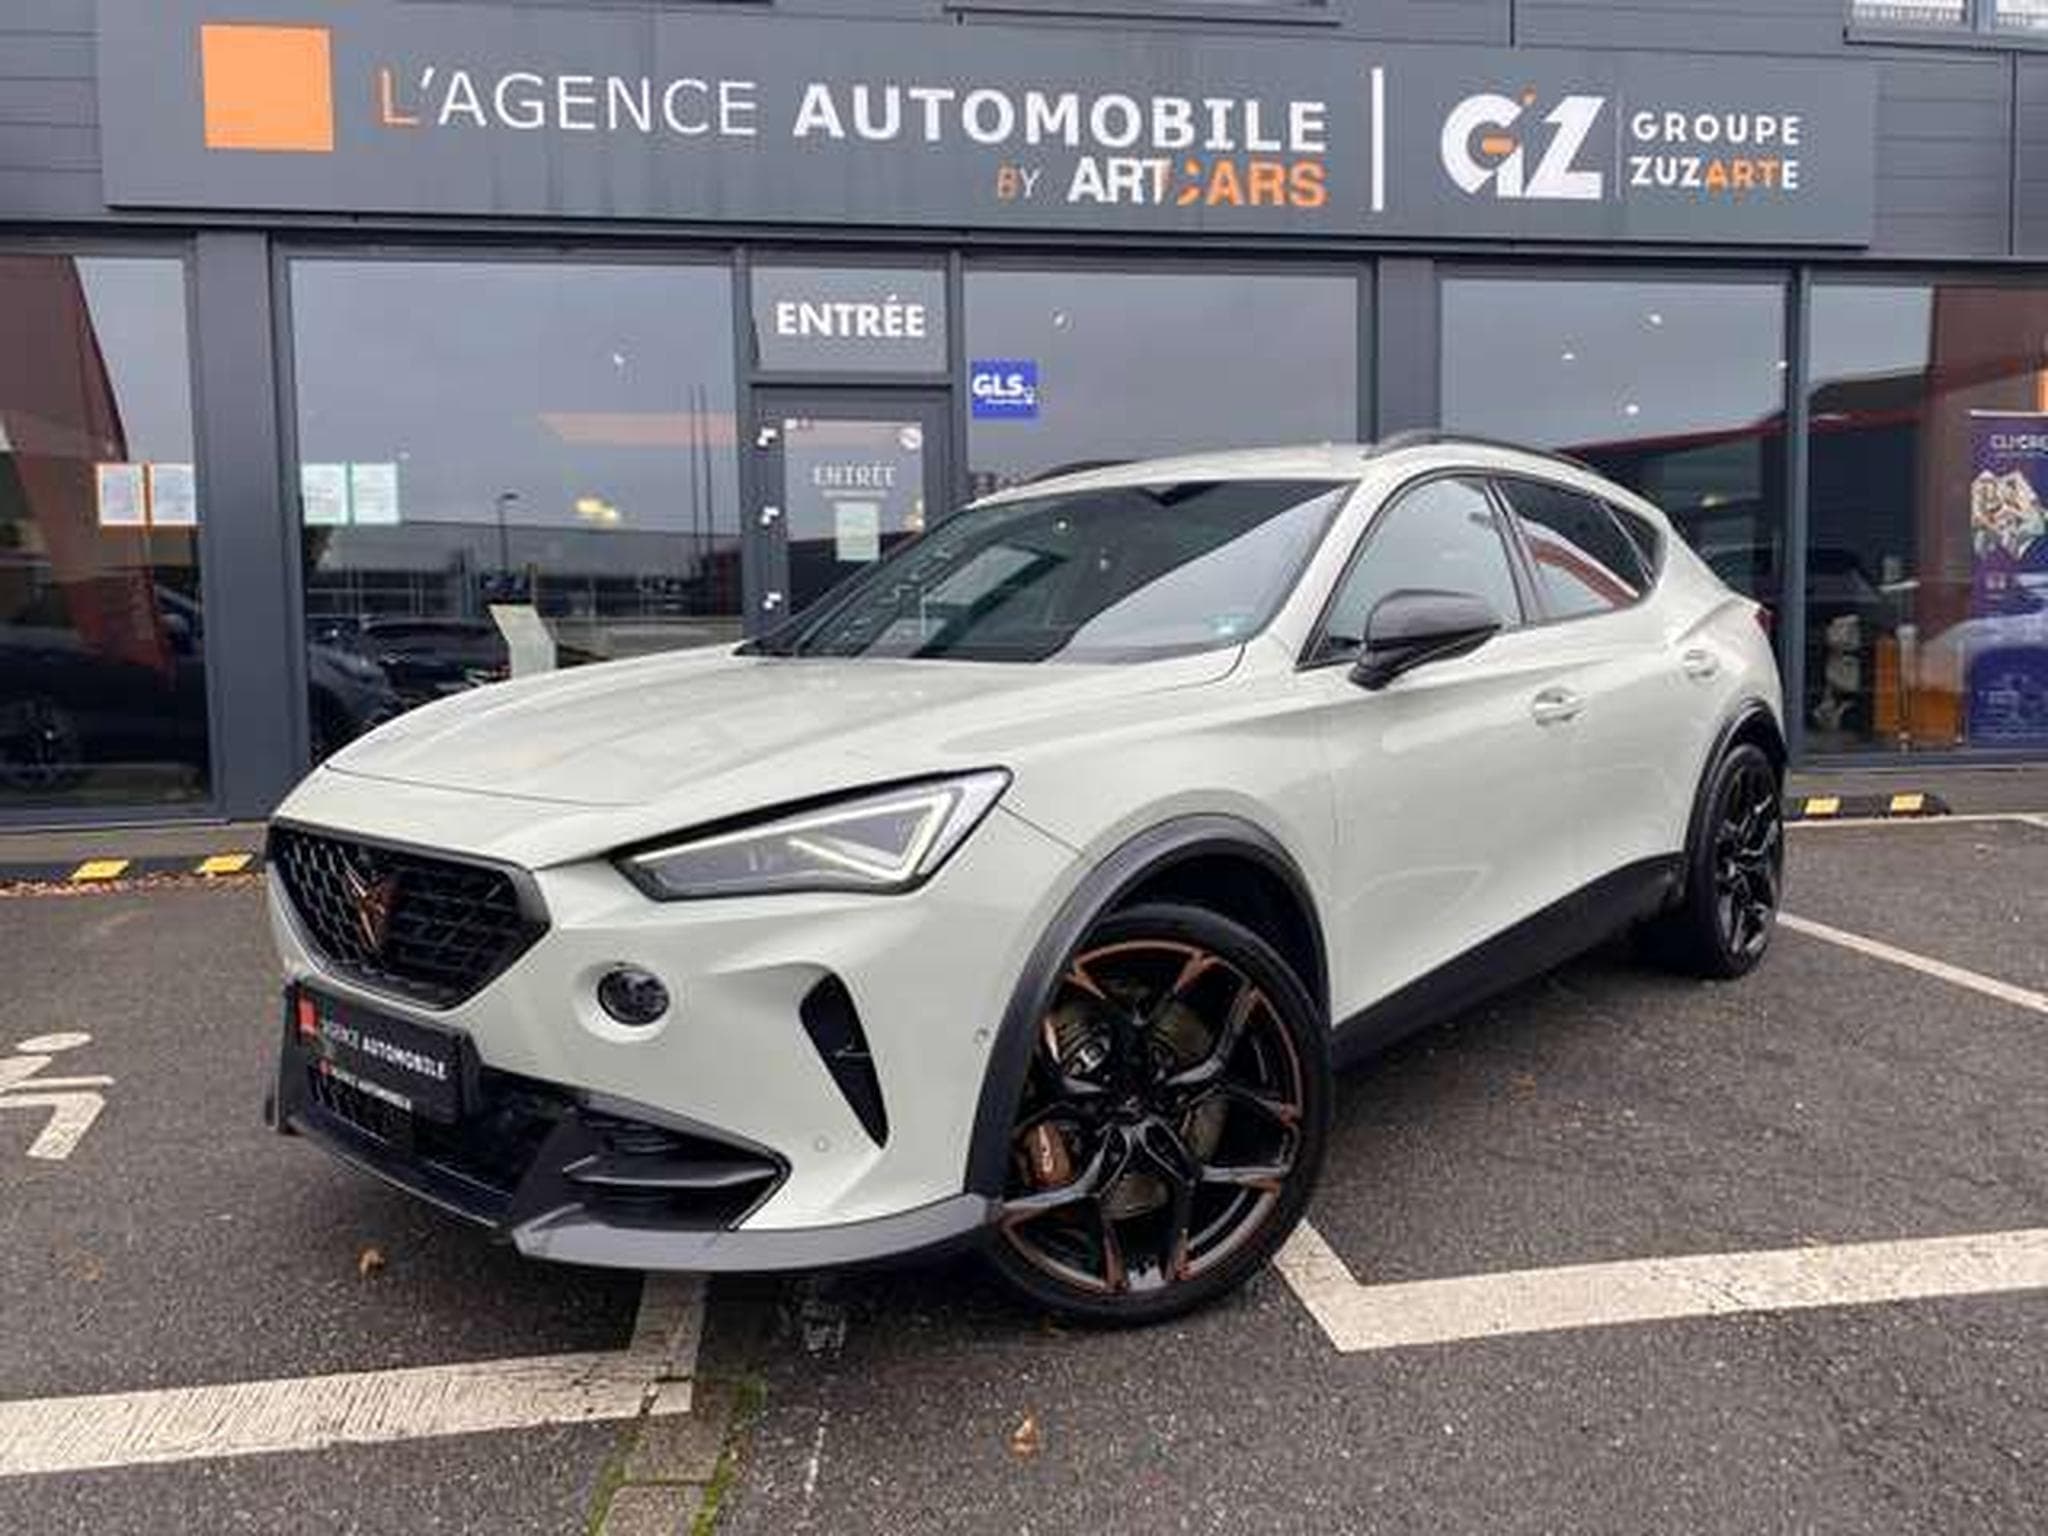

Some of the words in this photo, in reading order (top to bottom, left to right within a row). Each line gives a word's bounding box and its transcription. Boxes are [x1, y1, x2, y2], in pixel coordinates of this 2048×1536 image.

[378, 66, 759, 137] L'AGENCE
[793, 83, 1328, 152] AUTOMOBILE
[1631, 112, 1802, 145] GROUPE
[996, 166, 1040, 199] BY
[1630, 155, 1800, 191] ZUZARTE
[776, 293, 926, 337] ENTRÉE
[972, 373, 1025, 397] GLS
